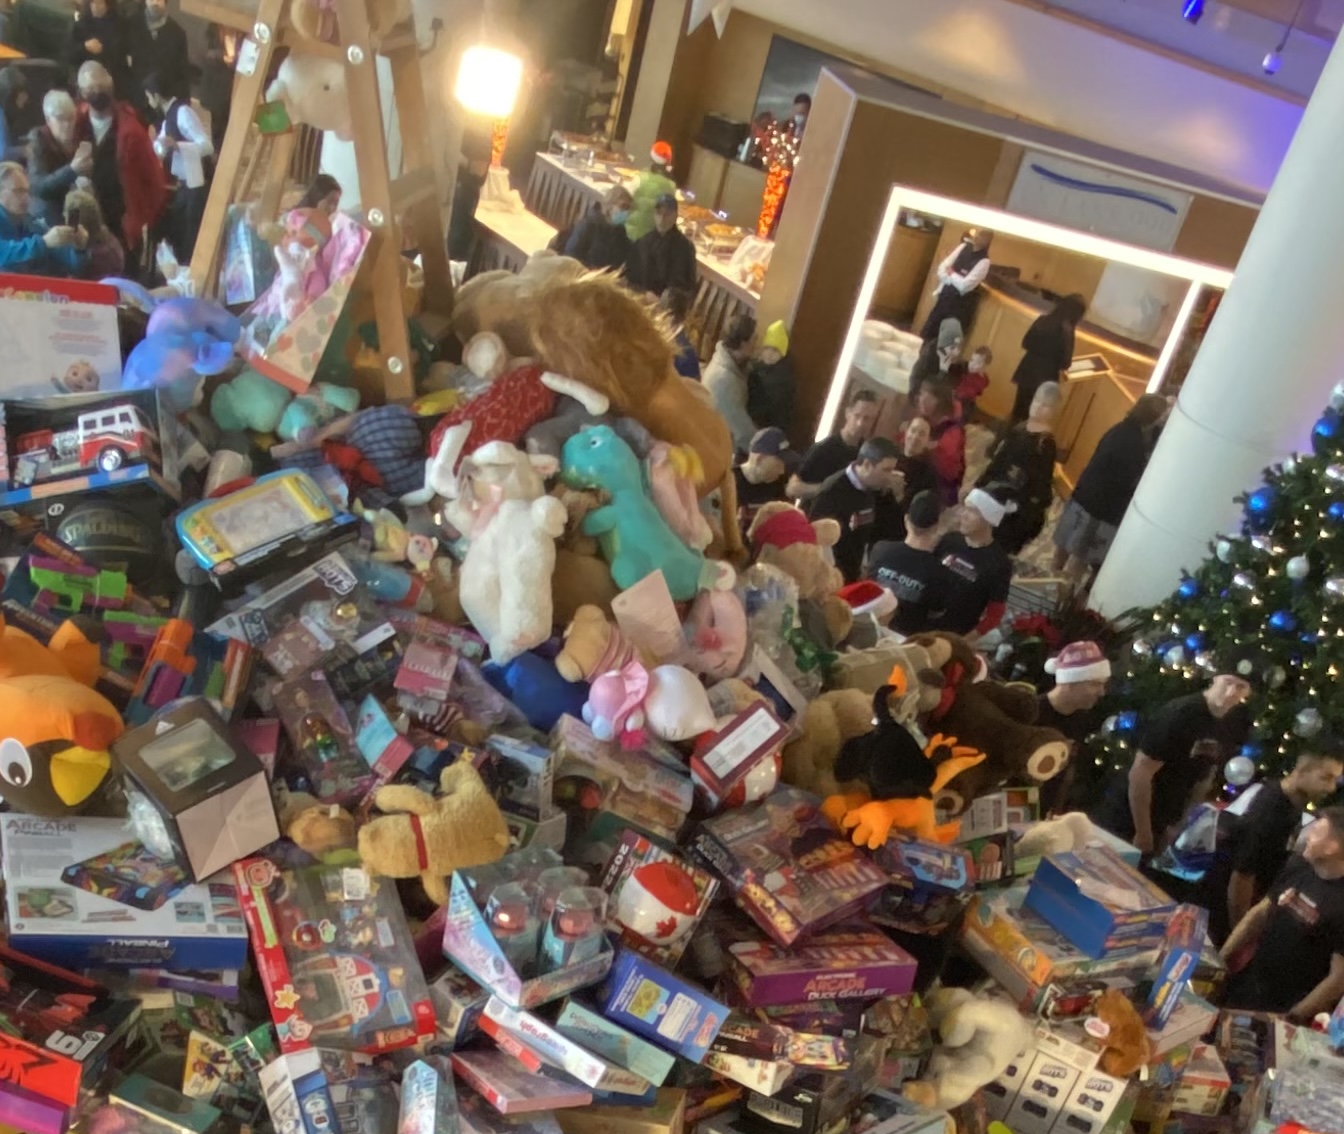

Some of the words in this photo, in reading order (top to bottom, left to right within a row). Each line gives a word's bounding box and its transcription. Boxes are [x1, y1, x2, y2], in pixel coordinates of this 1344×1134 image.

[104, 938, 170, 948] PINBALL
[804, 977, 866, 993] ARCADE
[808, 989, 837, 1001] DUCK
[838, 987, 887, 999] GALLERY
